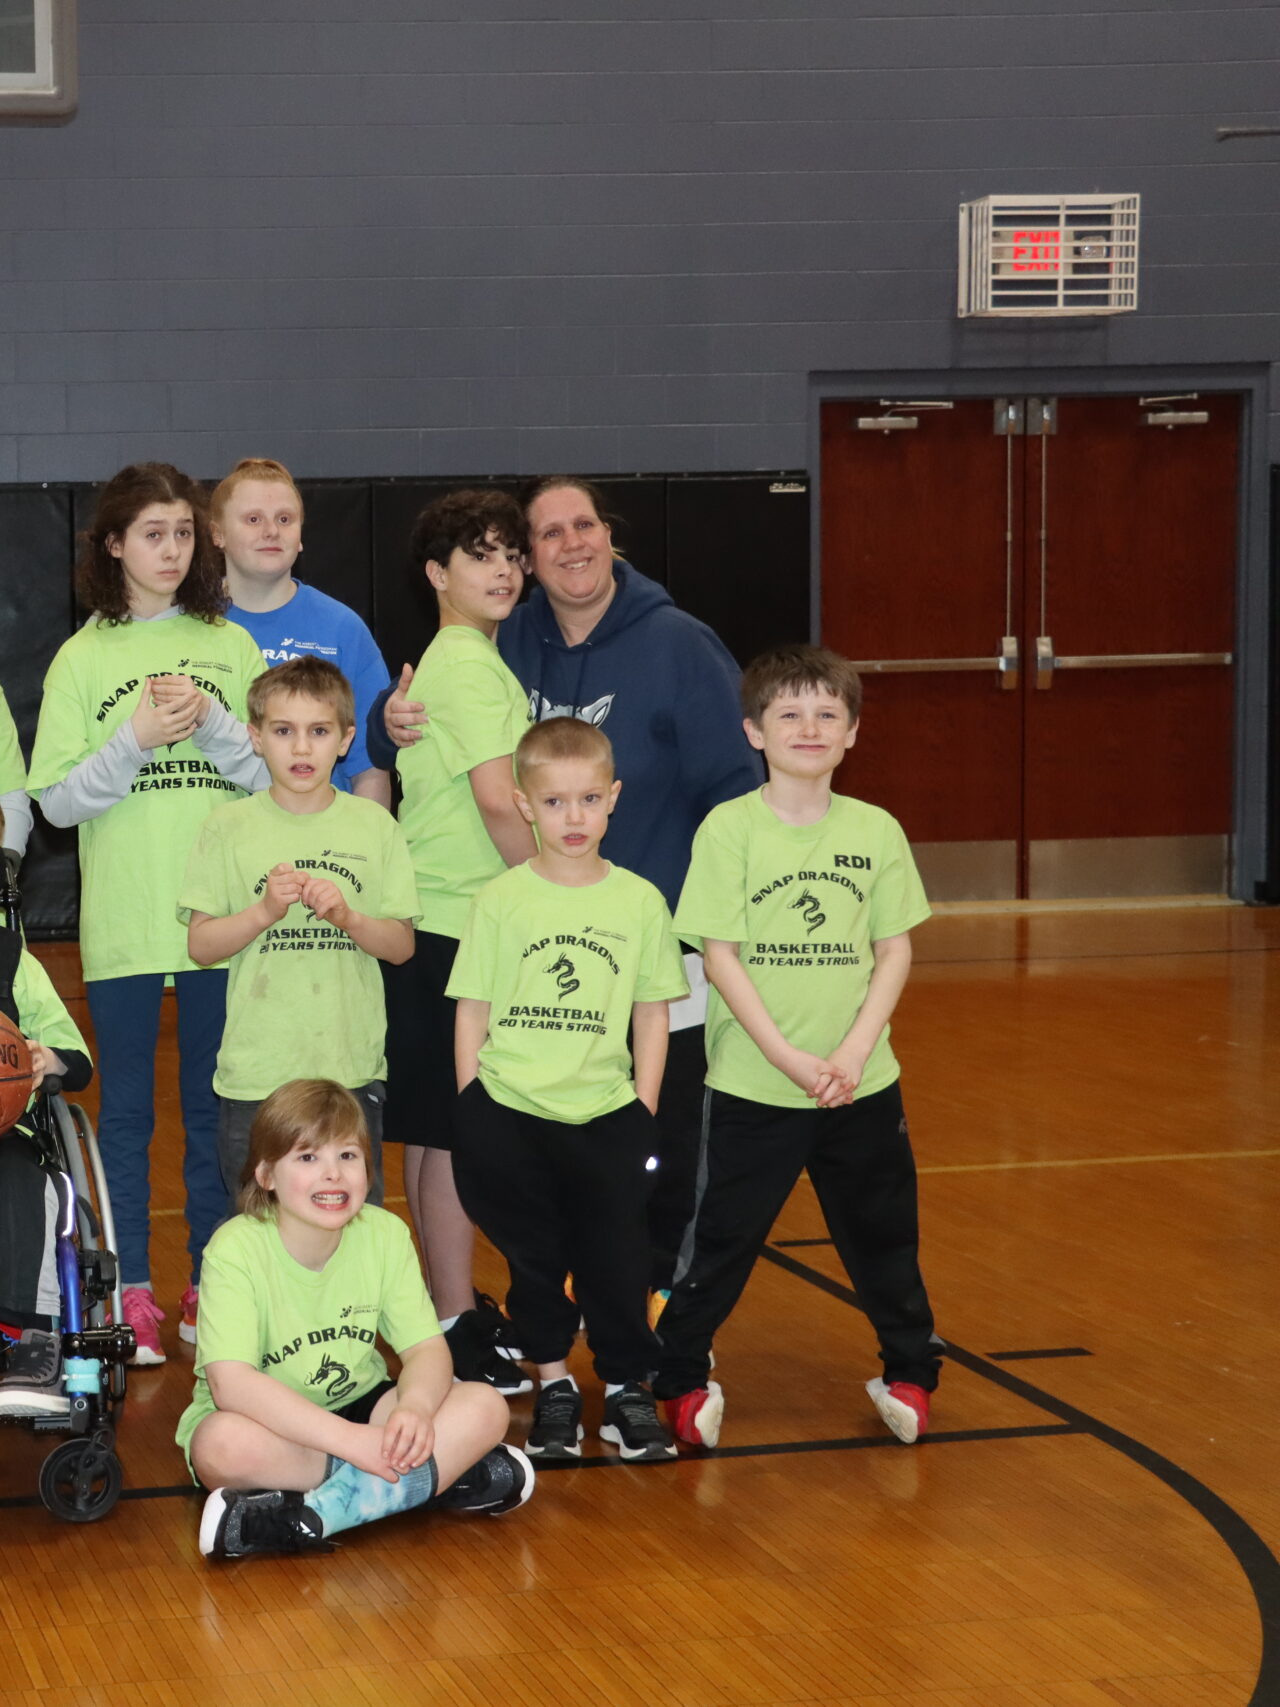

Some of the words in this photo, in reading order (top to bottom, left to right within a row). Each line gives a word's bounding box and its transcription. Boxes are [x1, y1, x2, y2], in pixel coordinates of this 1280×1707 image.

[1013, 231, 1060, 271] EXIT
[96, 679, 139, 723] SNAP
[131, 778, 182, 793] YEARS
[186, 777, 236, 792] STRONG
[834, 854, 872, 870] RDI
[295, 859, 363, 894] DRAGONS
[751, 874, 794, 905] SNAP
[798, 871, 864, 903] DRAGONS
[266, 928, 351, 941] BASKETBAL
[272, 941, 314, 951] YEARS
[317, 941, 357, 951] STRONG
[756, 943, 855, 954] BASKETBALL
[521, 937, 551, 960] NAP
[555, 935, 620, 975] DRAGONS
[749, 956, 764, 965] 20
[770, 956, 813, 966] YEARS
[816, 956, 860, 966] STRONG
[509, 1006, 605, 1022] BASKETBALL
[498, 1018, 518, 1027] 20
[521, 1019, 563, 1030] YEARS
[566, 1022, 607, 1035] STROG
[262, 1337, 302, 1368] SNAP
[307, 1325, 376, 1346] DRAGO
